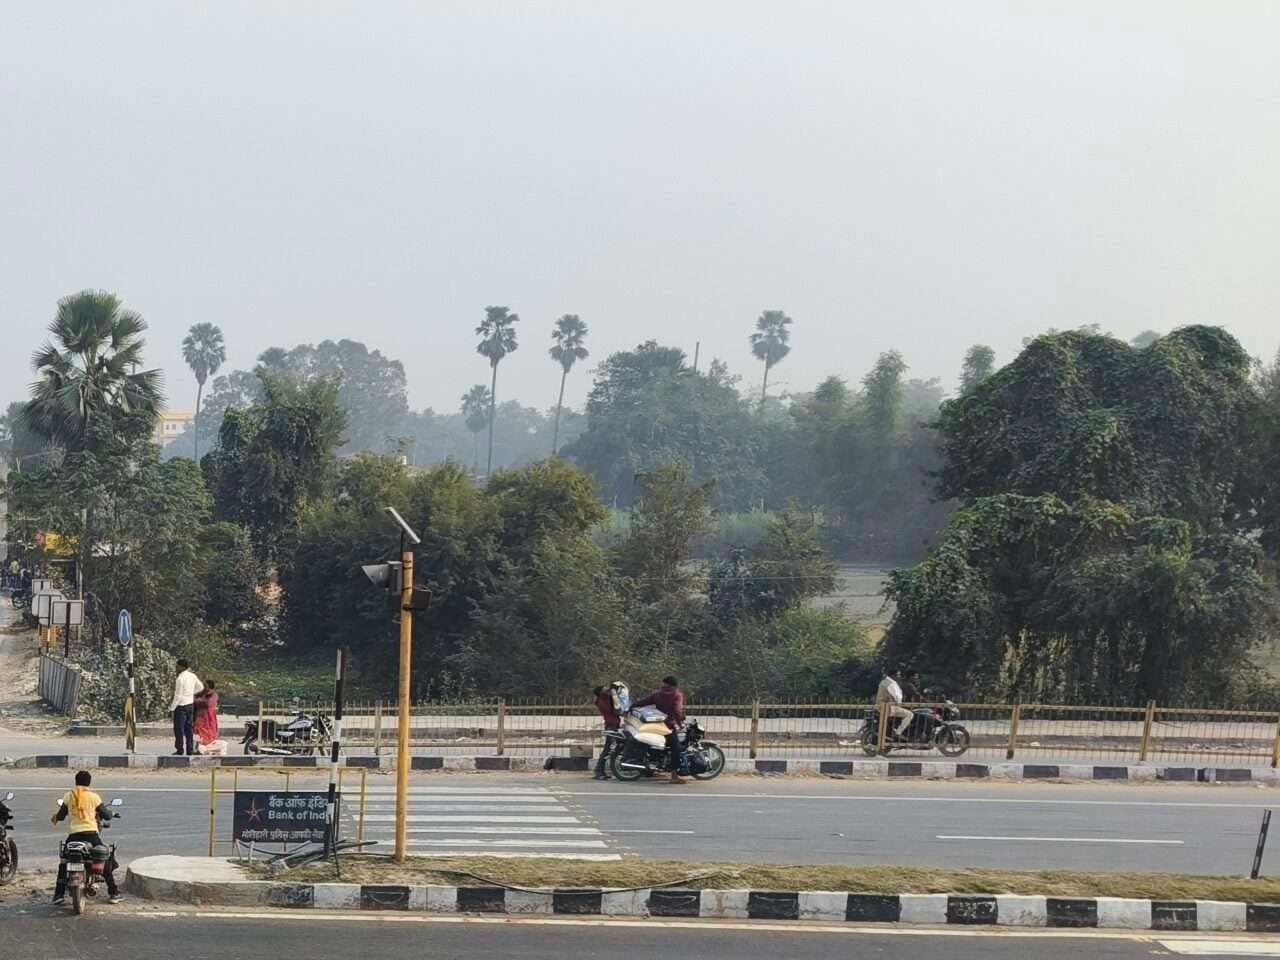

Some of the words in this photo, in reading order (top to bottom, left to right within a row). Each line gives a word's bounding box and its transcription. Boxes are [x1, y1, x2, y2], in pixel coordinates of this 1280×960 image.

[268, 810, 294, 820] Bank
[296, 810, 307, 820] of
[309, 810, 326, 820] Ind
